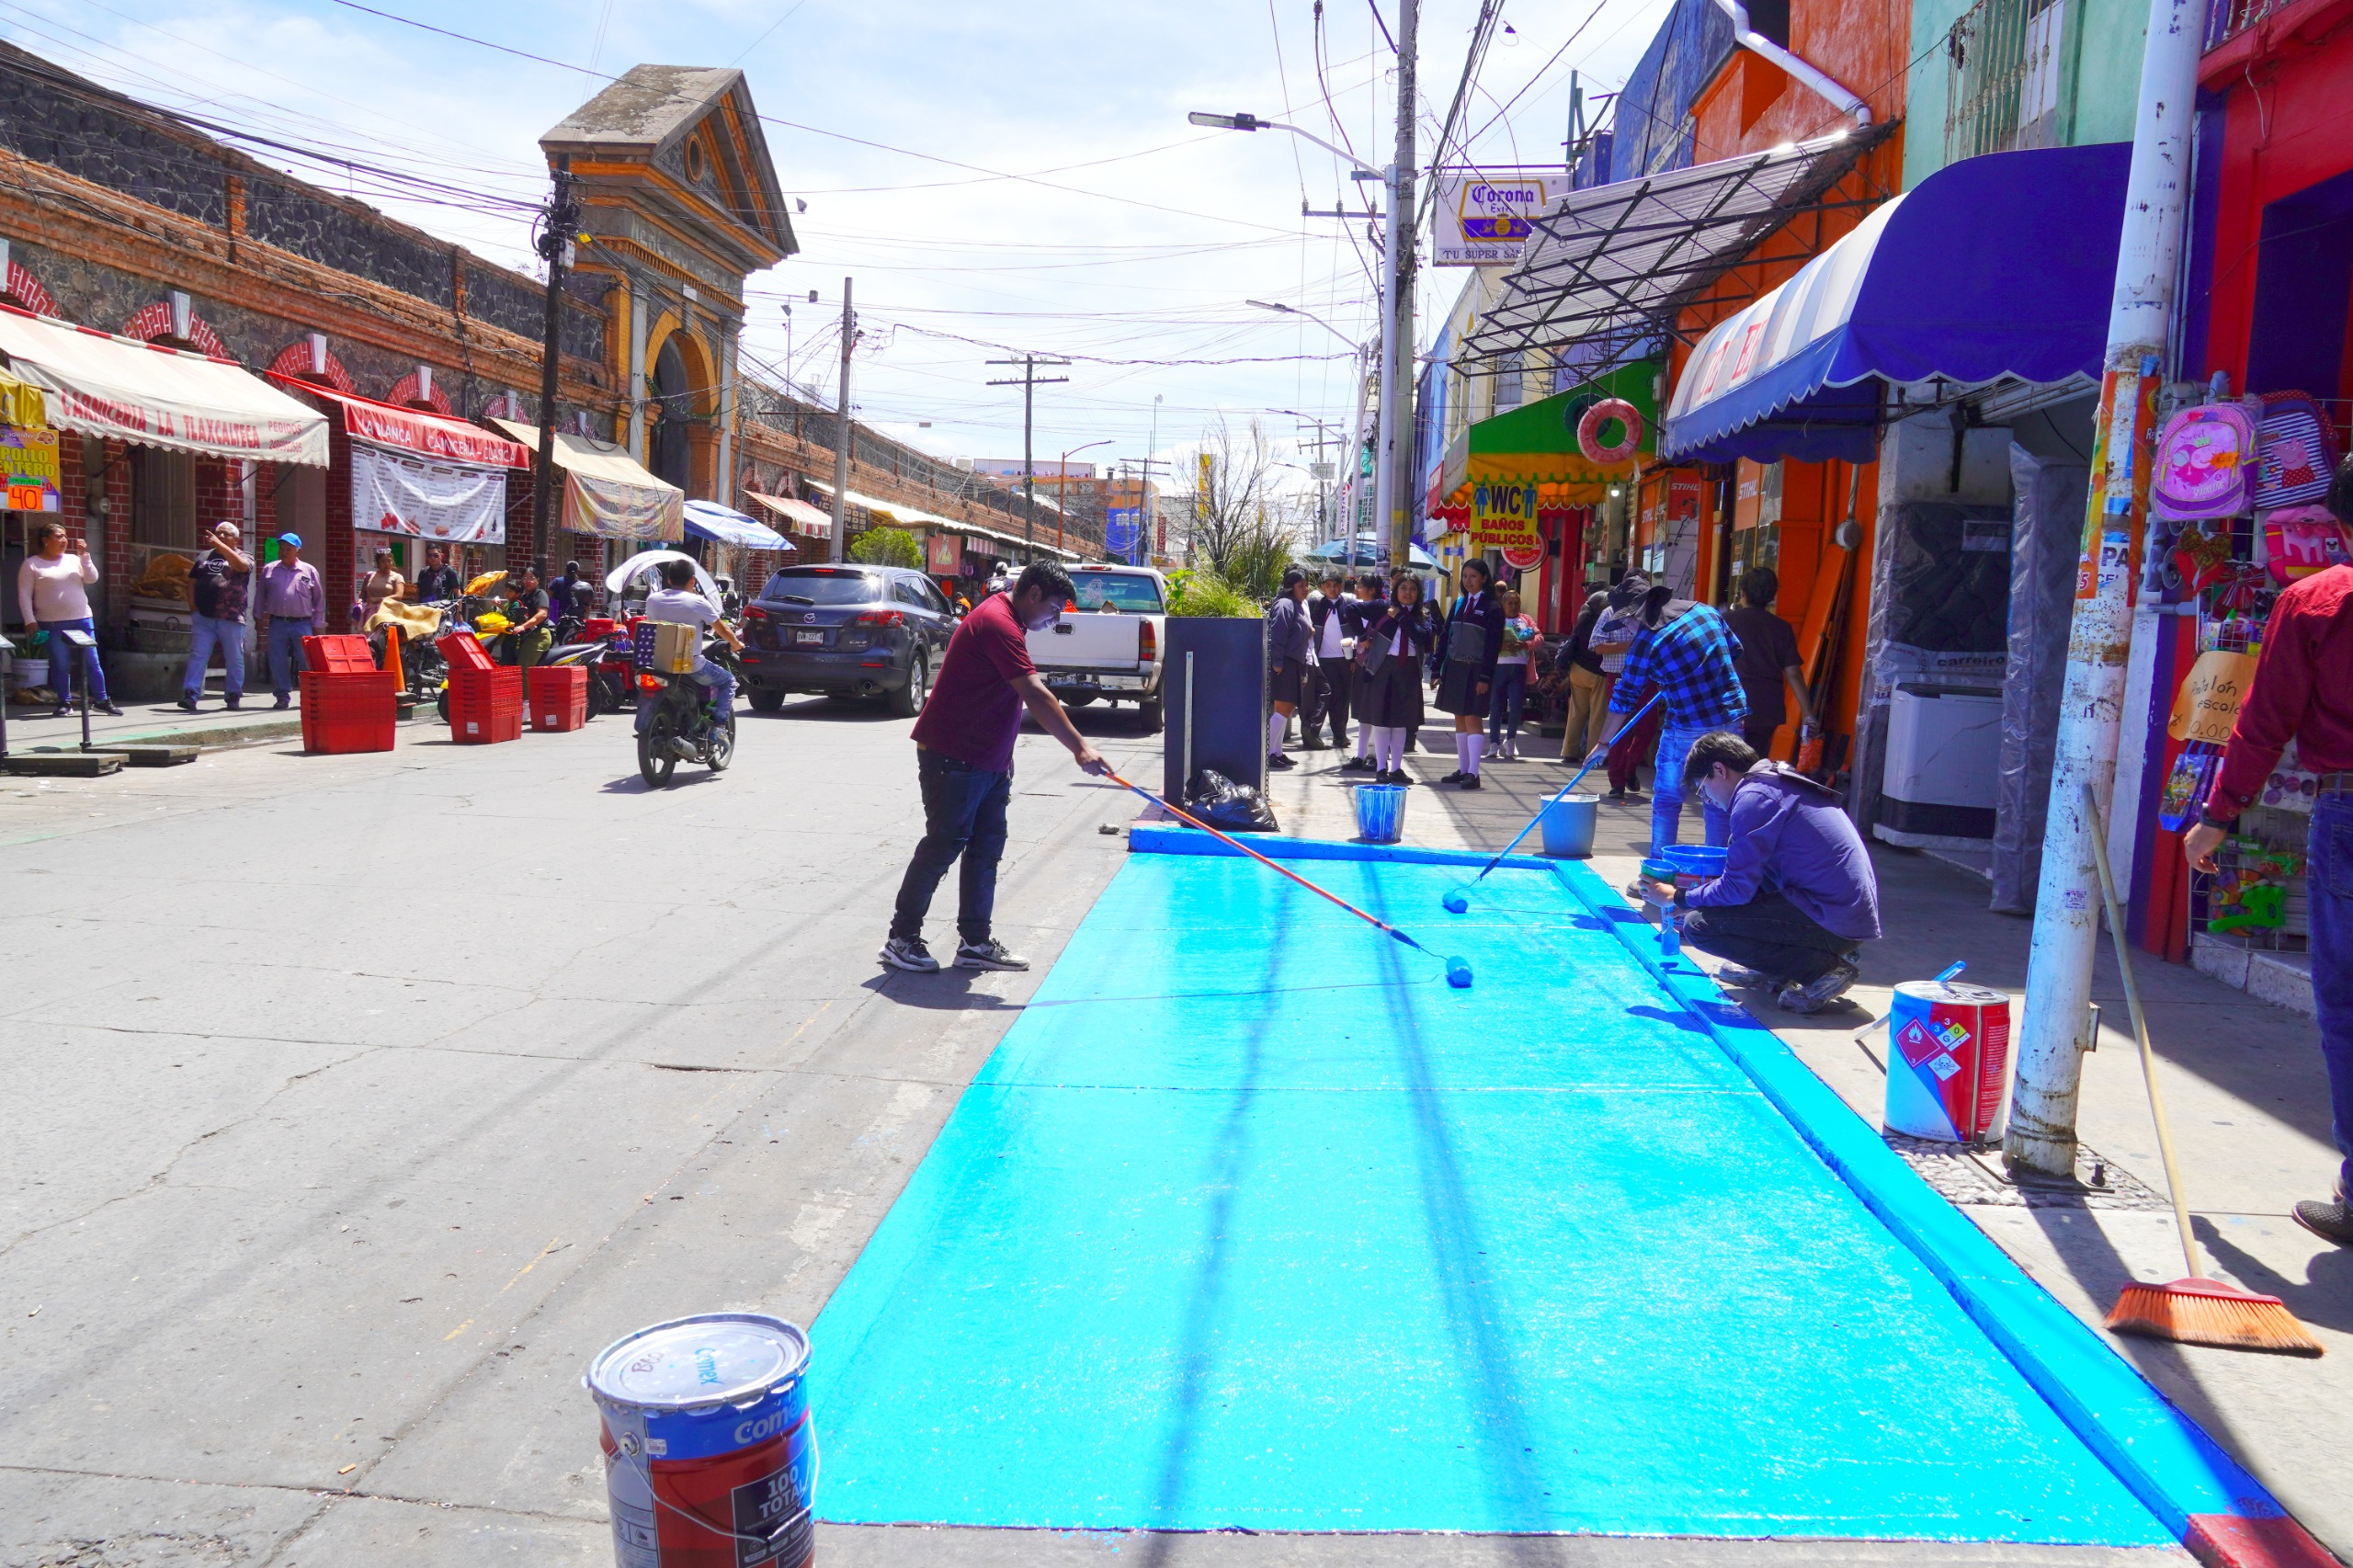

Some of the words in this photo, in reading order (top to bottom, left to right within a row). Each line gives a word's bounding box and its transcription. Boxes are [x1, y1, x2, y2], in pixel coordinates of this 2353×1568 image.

[1472, 185, 1535, 205] Corona
[1490, 203, 1515, 214] Extr
[1443, 249, 1460, 260] TU
[1465, 249, 1498, 260] SUPER
[157, 410, 175, 437] LA
[184, 415, 260, 449] TLAXCALTECA
[267, 420, 302, 436] PEDIDOS
[361, 418, 374, 434] LA
[376, 422, 413, 444] BLANCA
[0, 446, 50, 463] POLLO
[1670, 483, 1700, 492] STIHL
[1737, 479, 1757, 501] STIHL
[11, 489, 39, 510] 40
[811, 499, 867, 518] LICDOS
[1491, 485, 1522, 515] WC
[1481, 517, 1525, 531] BAÑOS
[1471, 531, 1535, 546] PÚBLICOS
[1937, 655, 2006, 667] carreiro
[1934, 1025, 1940, 1033] 3
[1954, 1027, 1960, 1035] 0
[734, 1399, 798, 1445] Come
[767, 1464, 800, 1500] 100
[759, 1478, 807, 1518] TOTAL
